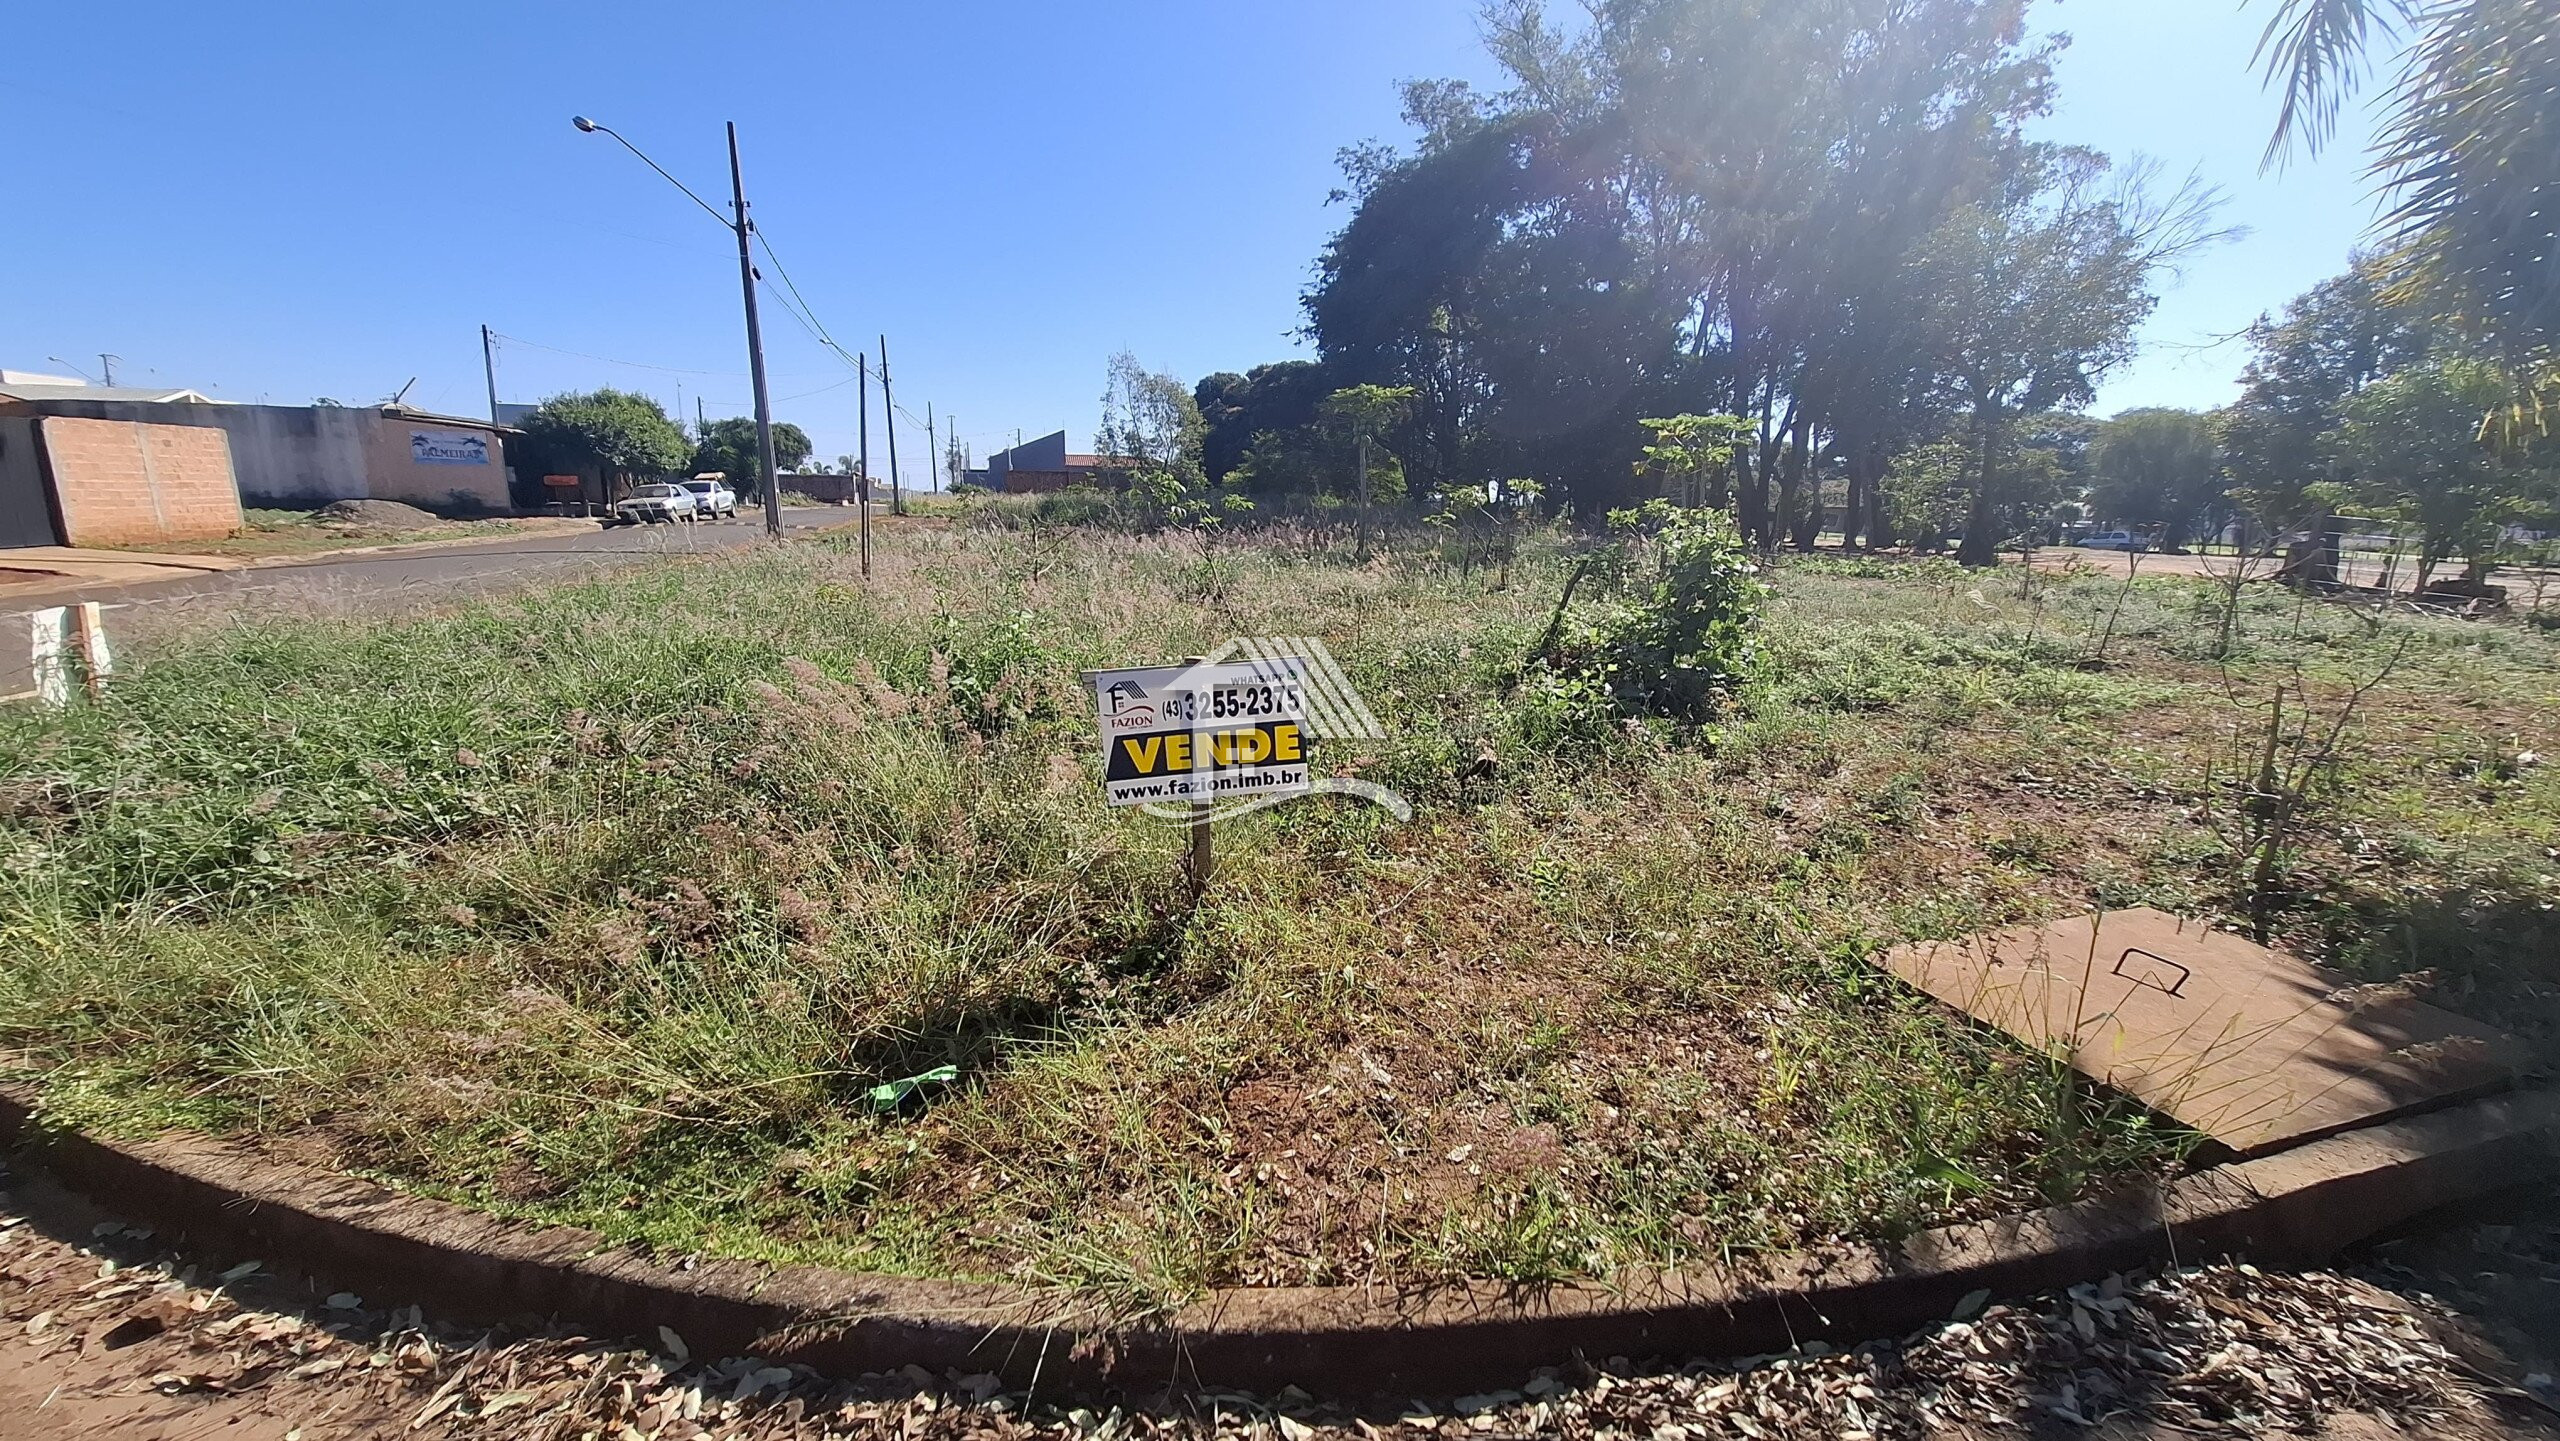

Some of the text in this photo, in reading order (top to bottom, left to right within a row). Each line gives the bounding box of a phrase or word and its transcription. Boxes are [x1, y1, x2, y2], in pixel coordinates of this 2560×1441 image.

[1230, 672, 1285, 686] WHATSAPP
[1162, 686, 1300, 721] (43) 3255-2375
[1111, 716, 1153, 729] FAZION
[1123, 725, 1301, 774] VENDE
[1114, 769, 1302, 800] www.fazion.imb.br
